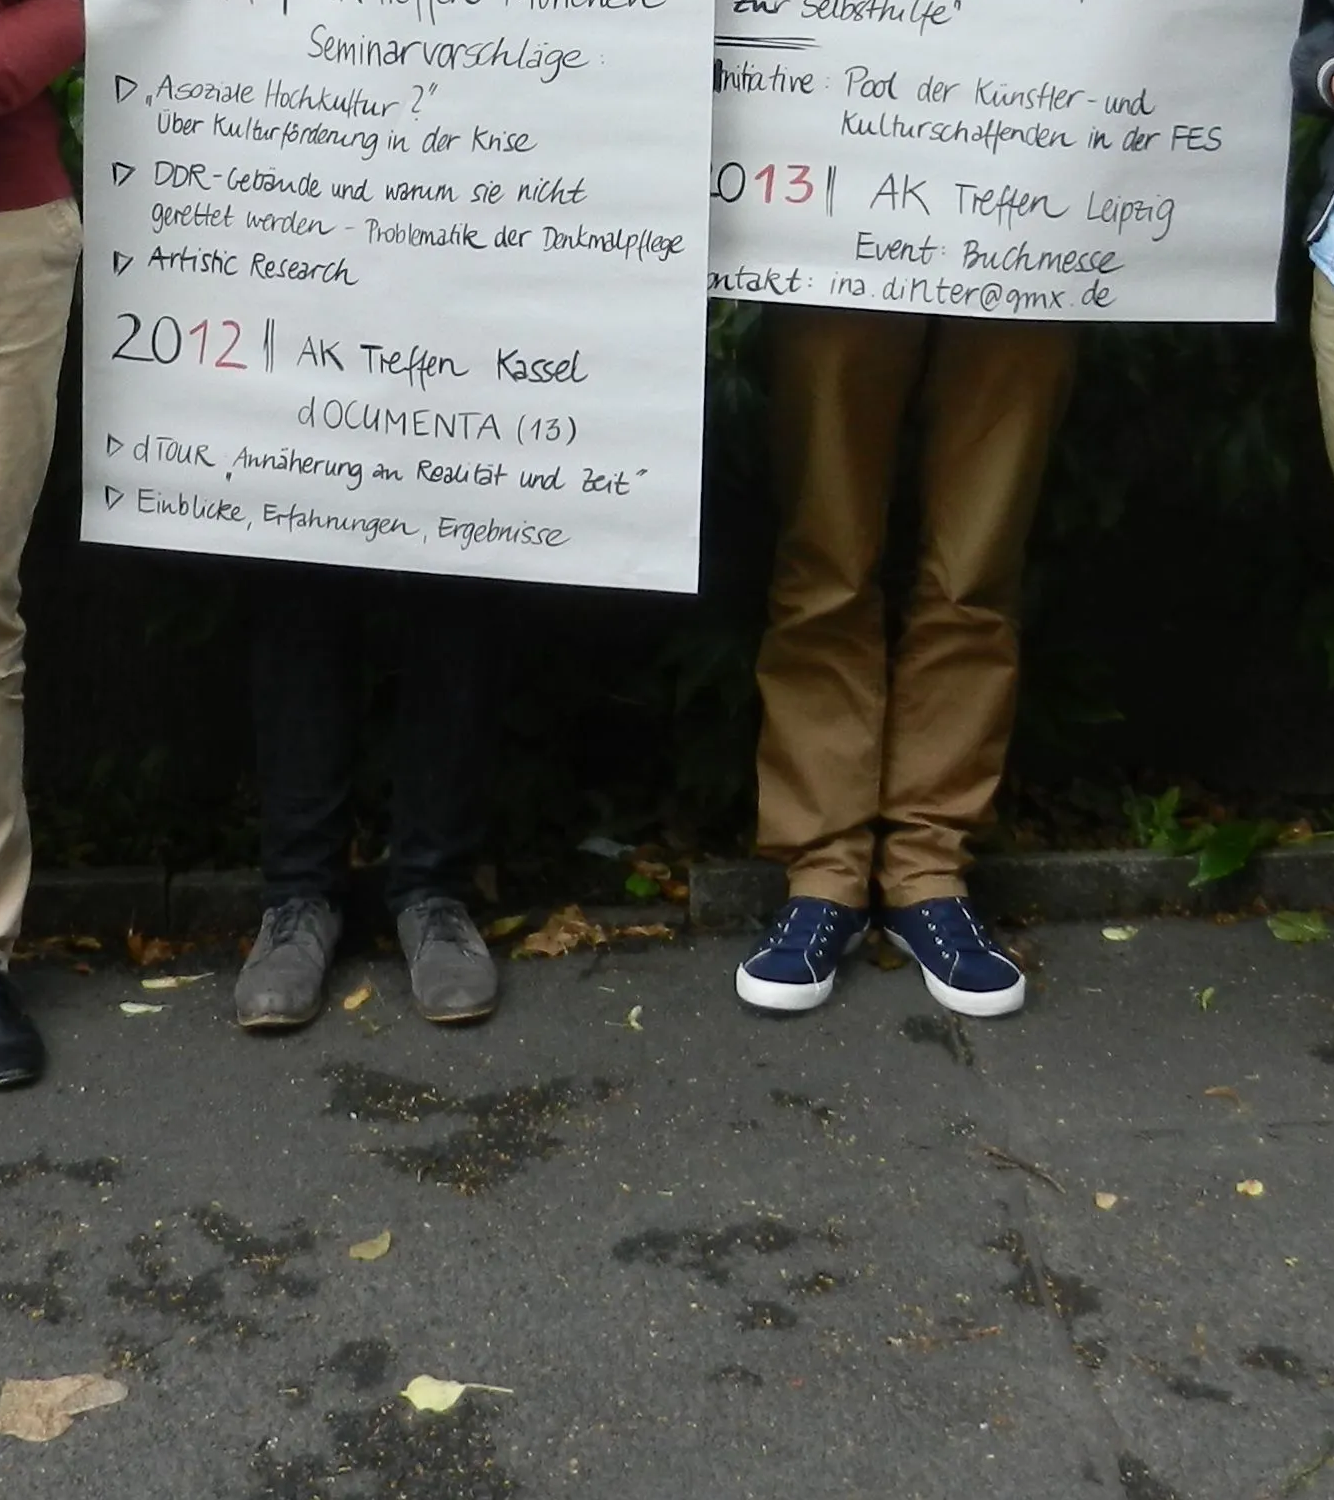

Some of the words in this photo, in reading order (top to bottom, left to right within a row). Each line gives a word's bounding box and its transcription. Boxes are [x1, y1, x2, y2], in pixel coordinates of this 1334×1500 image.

[265, 79, 400, 118] Hochkultur
[844, 65, 899, 100] Pool
[917, 75, 960, 103] der
[1104, 88, 1155, 116] und
[157, 108, 204, 134] Über
[214, 116, 378, 160] Kulturförderung
[388, 131, 410, 153] in
[422, 126, 460, 153] der
[471, 126, 538, 153] Krise
[841, 109, 1076, 154] Kulturschaffenden
[1087, 127, 1112, 150] in
[1121, 127, 1161, 151] der
[1171, 125, 1222, 151] FES
[331, 179, 374, 201] und
[385, 183, 460, 202] warum
[470, 180, 505, 203] sie
[517, 177, 587, 204] nicht
[710, 162, 814, 204] 013
[870, 172, 931, 216] AK
[955, 183, 1069, 231] Treffen
[1086, 190, 1175, 242] Leipzig
[151, 202, 234, 233] gerettet
[246, 210, 335, 236] werden
[365, 217, 487, 249] Problematik
[494, 225, 532, 248] der
[542, 224, 686, 261] Denkmalpflege
[148, 245, 239, 275] Artistic
[250, 252, 359, 286] Research
[963, 239, 1125, 274] Buchmesse
[111, 312, 248, 369] 2012
[297, 335, 344, 371] AK
[359, 344, 469, 391] Treffen
[497, 348, 589, 383] Kassel
[298, 396, 501, 441] dOCUMENTA
[517, 413, 577, 446] (13)
[372, 463, 403, 481] an
[417, 460, 507, 486] Realität
[519, 466, 565, 490] und
[438, 515, 571, 550] Ergebnisse
